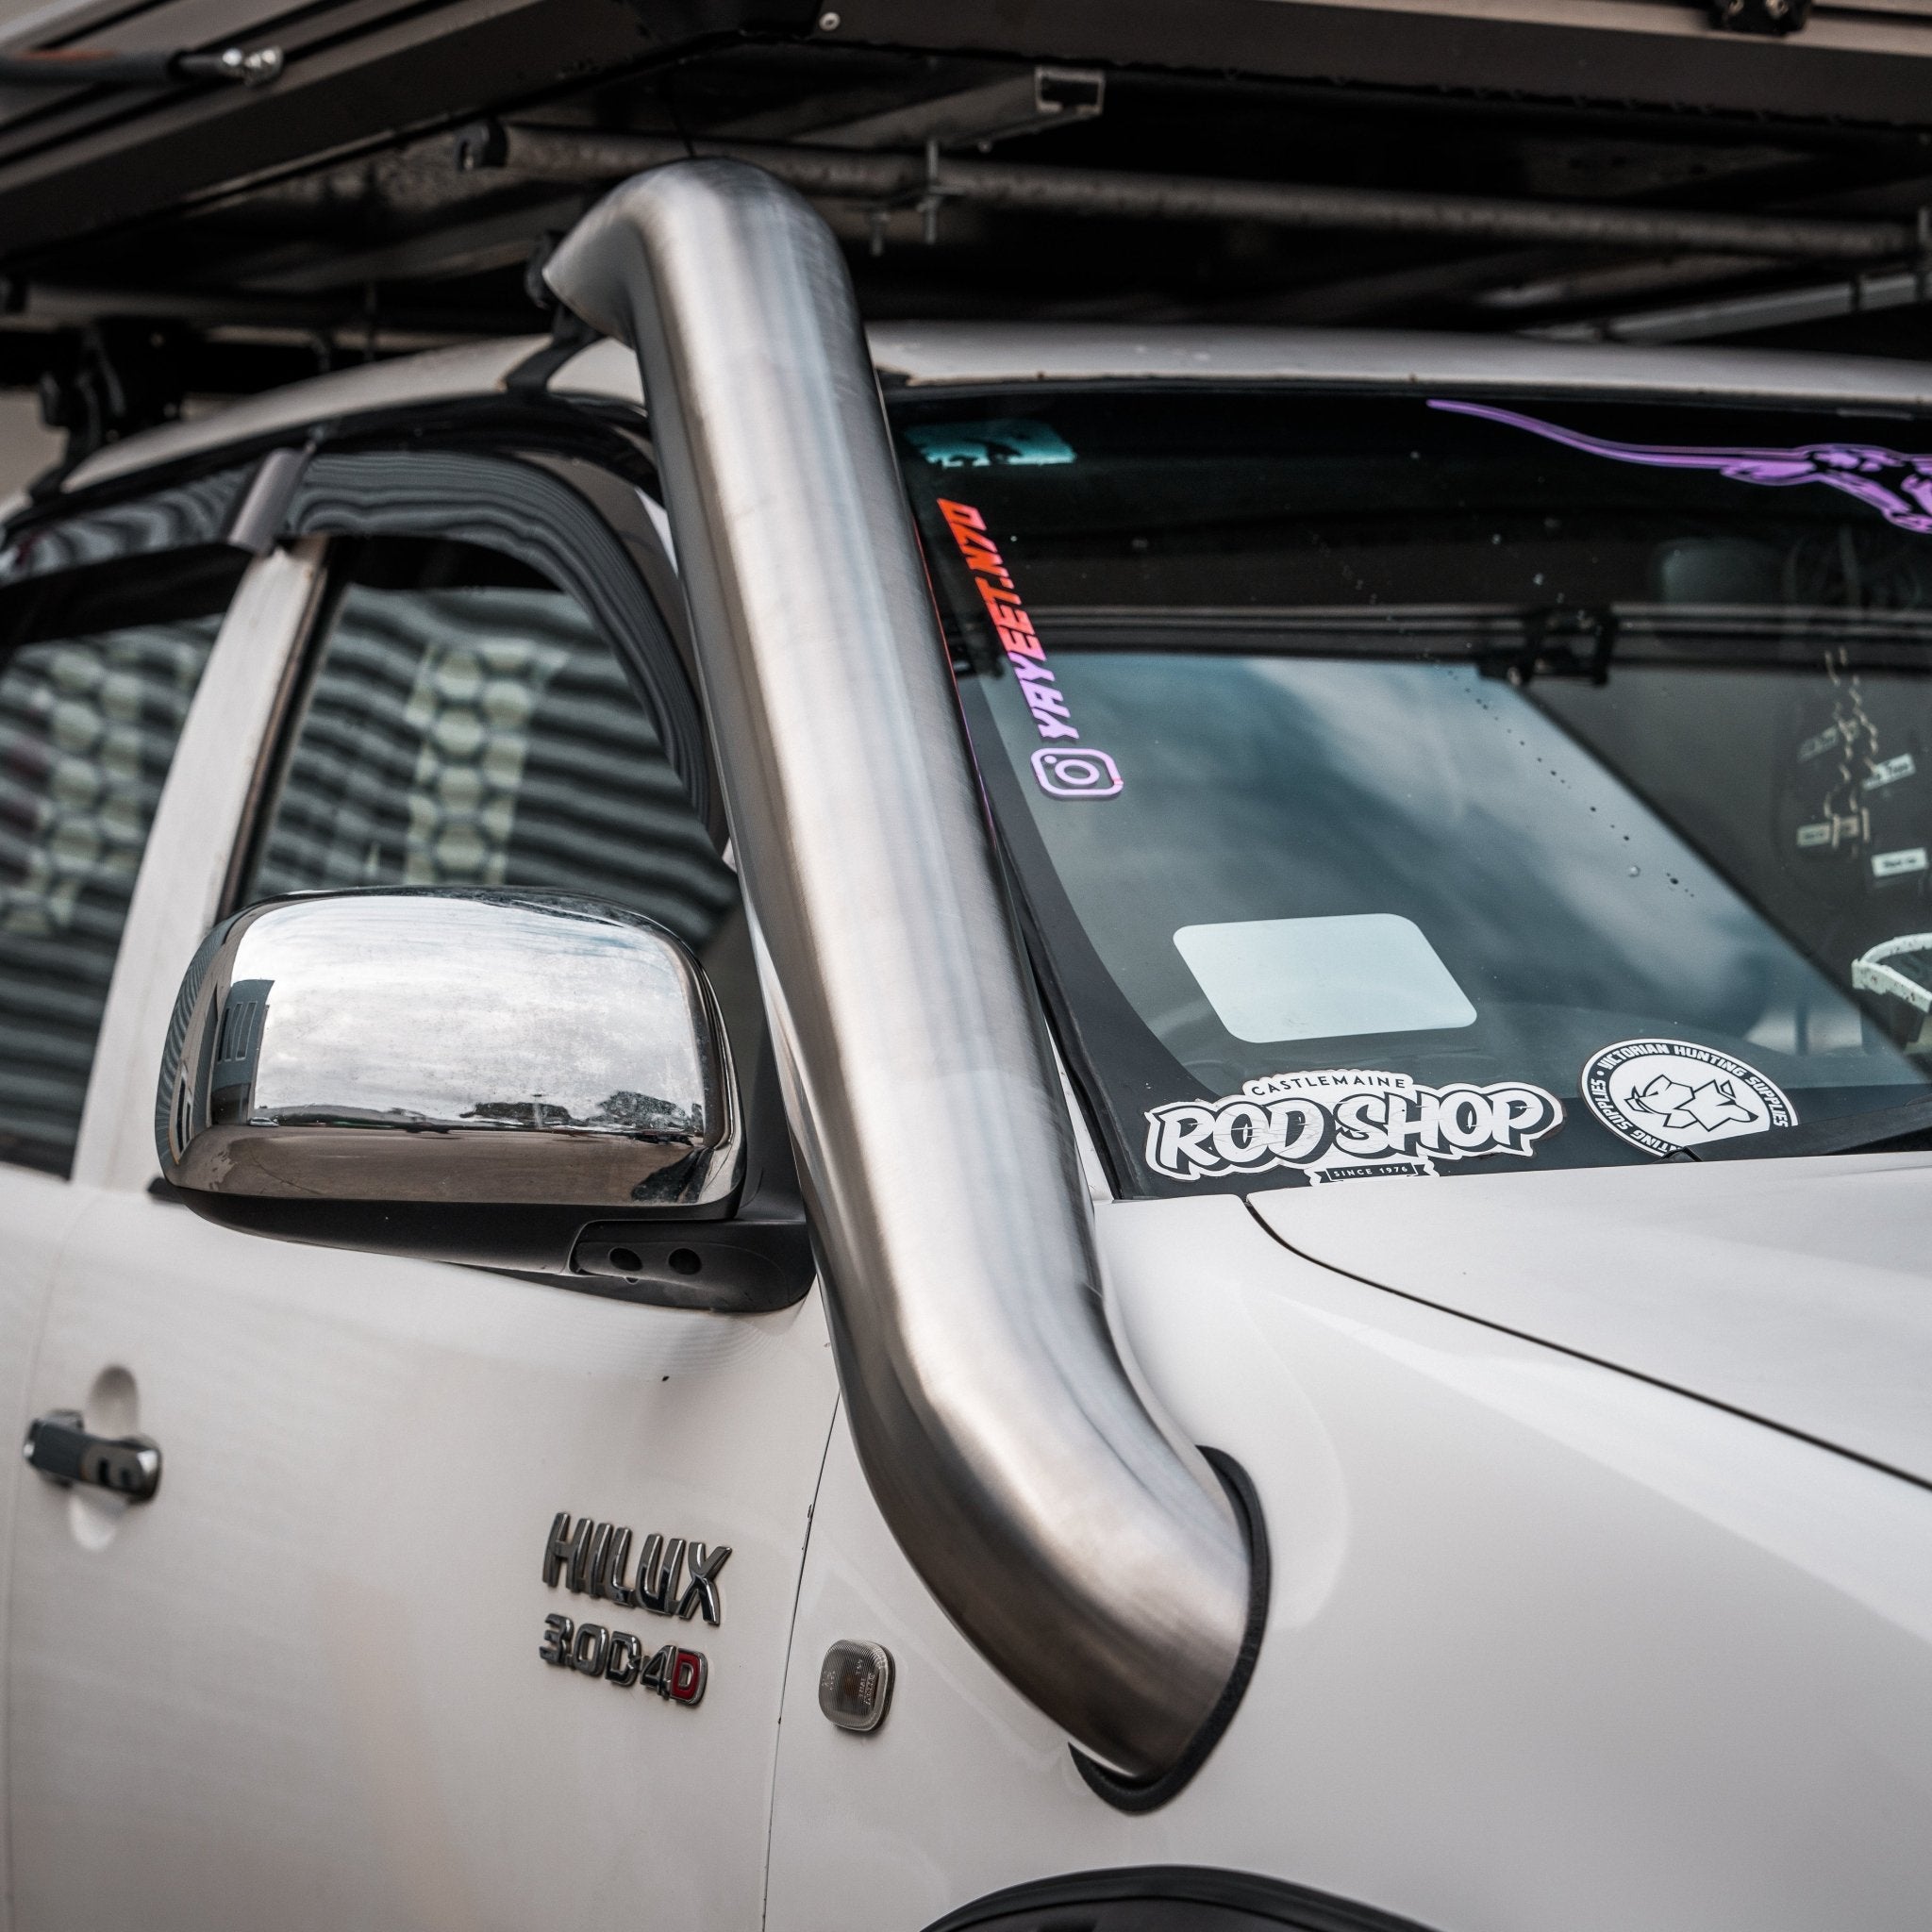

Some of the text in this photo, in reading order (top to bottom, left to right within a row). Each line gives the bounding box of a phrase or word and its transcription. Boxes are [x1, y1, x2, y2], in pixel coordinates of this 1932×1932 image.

[1250, 1074, 1407, 1097] CASTLEMAINE
[1590, 1076, 1630, 1132] SUPPLIES
[1596, 1043, 1790, 1128] VICTORIAN HUNTING SUPPLIES
[1155, 1089, 1547, 1171] ROD SHOP
[1333, 1165, 1409, 1178] SINCE 1976
[541, 1511, 733, 1626] HILUX
